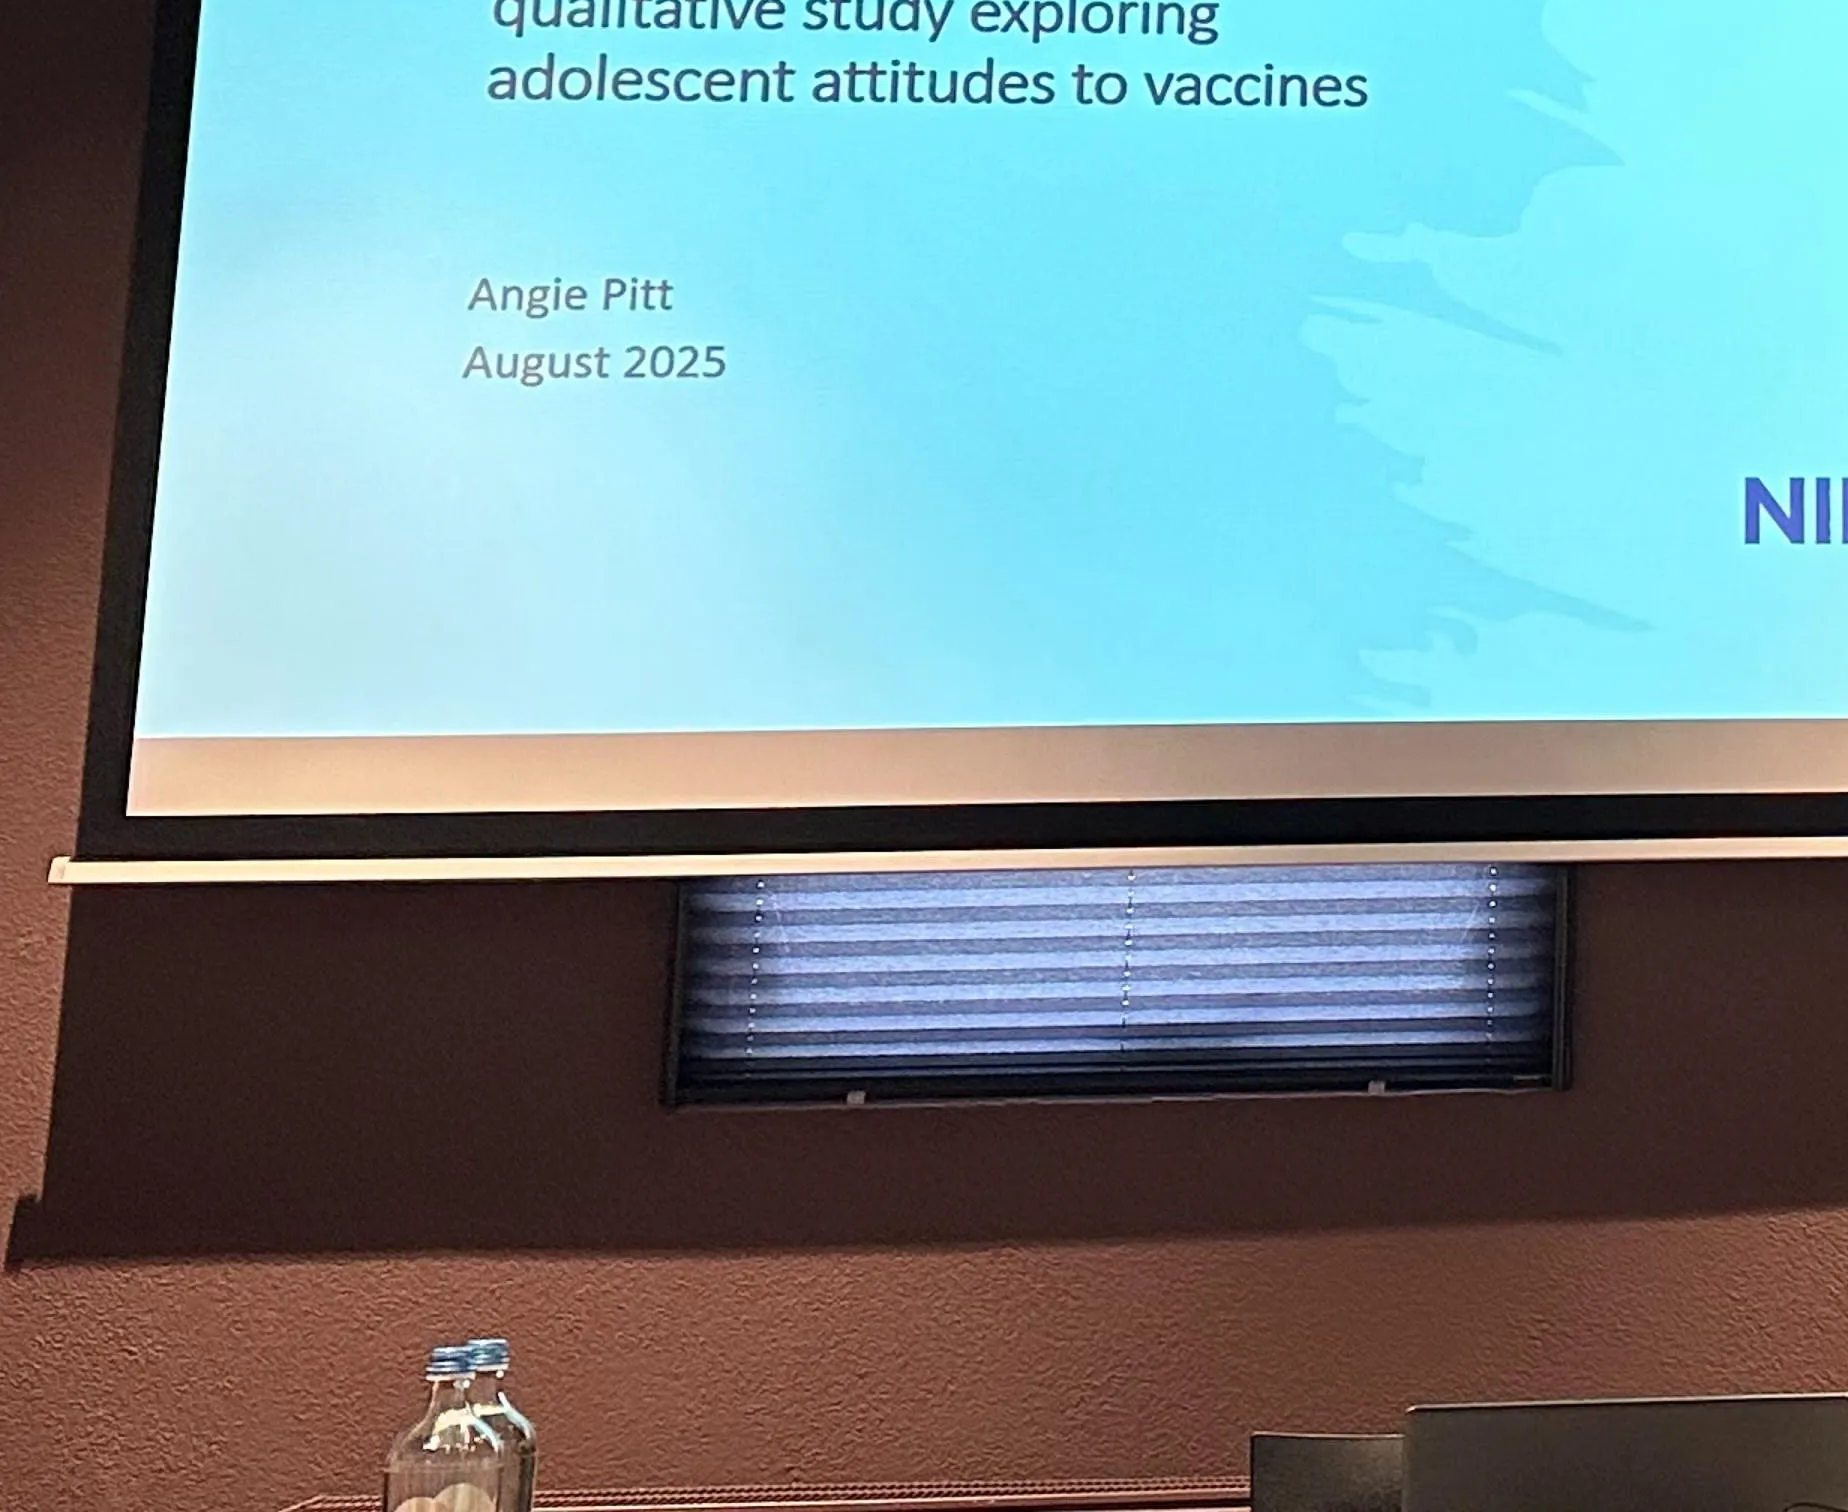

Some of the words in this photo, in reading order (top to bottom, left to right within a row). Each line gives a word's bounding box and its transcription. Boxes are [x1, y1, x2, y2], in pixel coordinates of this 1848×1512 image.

[488, 52, 796, 102] adolescent
[813, 57, 1055, 104] attitudes
[1072, 64, 1127, 104] to
[1144, 63, 1367, 107] vaccines
[468, 277, 587, 319] Angie
[603, 277, 674, 310] Pitt
[462, 346, 611, 387] August
[624, 346, 725, 378] 2025
